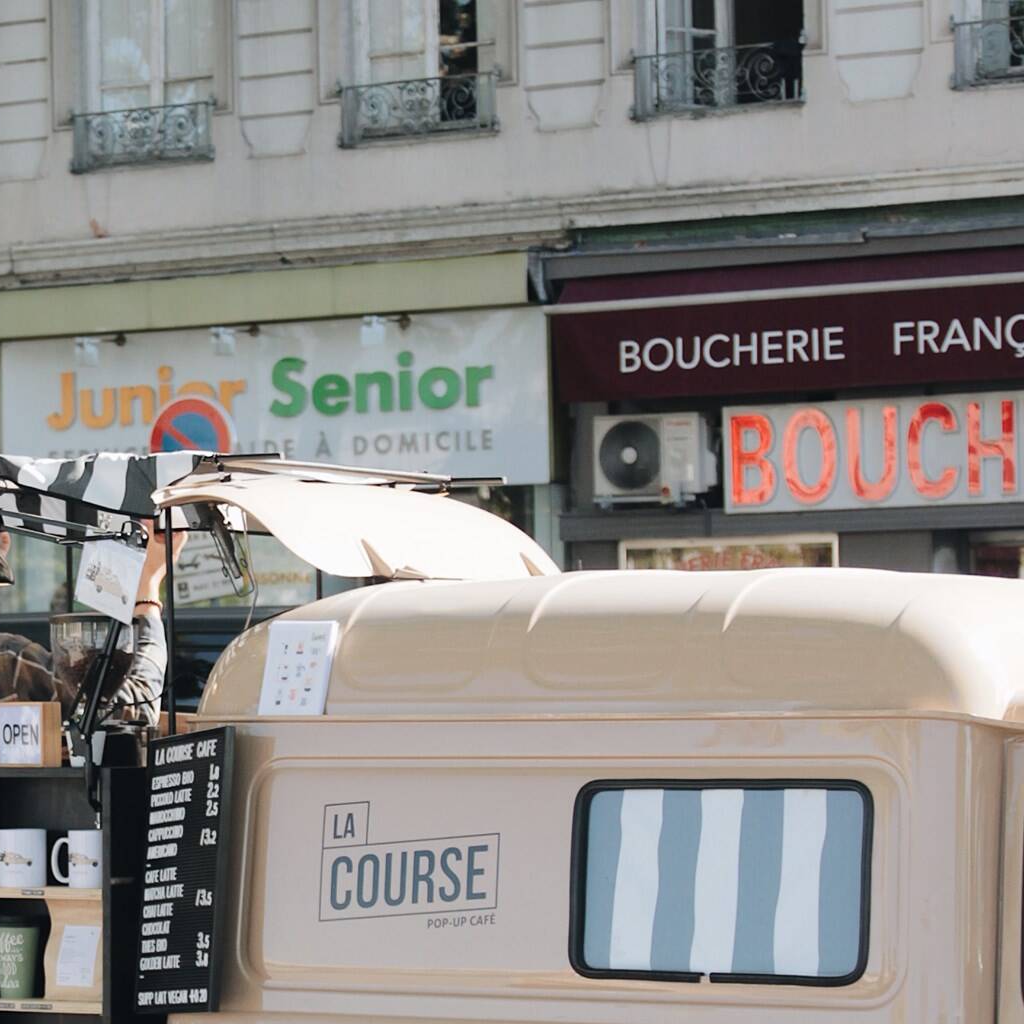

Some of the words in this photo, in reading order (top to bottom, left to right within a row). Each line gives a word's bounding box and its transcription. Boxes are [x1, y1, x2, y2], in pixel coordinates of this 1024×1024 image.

[620, 326, 845, 374] BOUCHERIE
[270, 351, 493, 418] Senior
[315, 432, 333, 459] À
[353, 429, 493, 457] DOMICILE
[730, 400, 1014, 506] BOUCH
[2, 723, 40, 746] OPEN
[155, 748, 165, 766] LA
[166, 743, 194, 763] COURSE
[196, 739, 217, 758] CAFE
[174, 788, 192, 804] LATTE
[206, 800, 219, 817] 2.5
[333, 813, 355, 840] LA
[160, 867, 177, 882] LATTE
[330, 844, 489, 911] COURSE
[166, 884, 184, 899] LATTE
[426, 915, 467, 929] POP-UP
[469, 912, 496, 927] CAFÉ
[196, 931, 210, 949] 3.5
